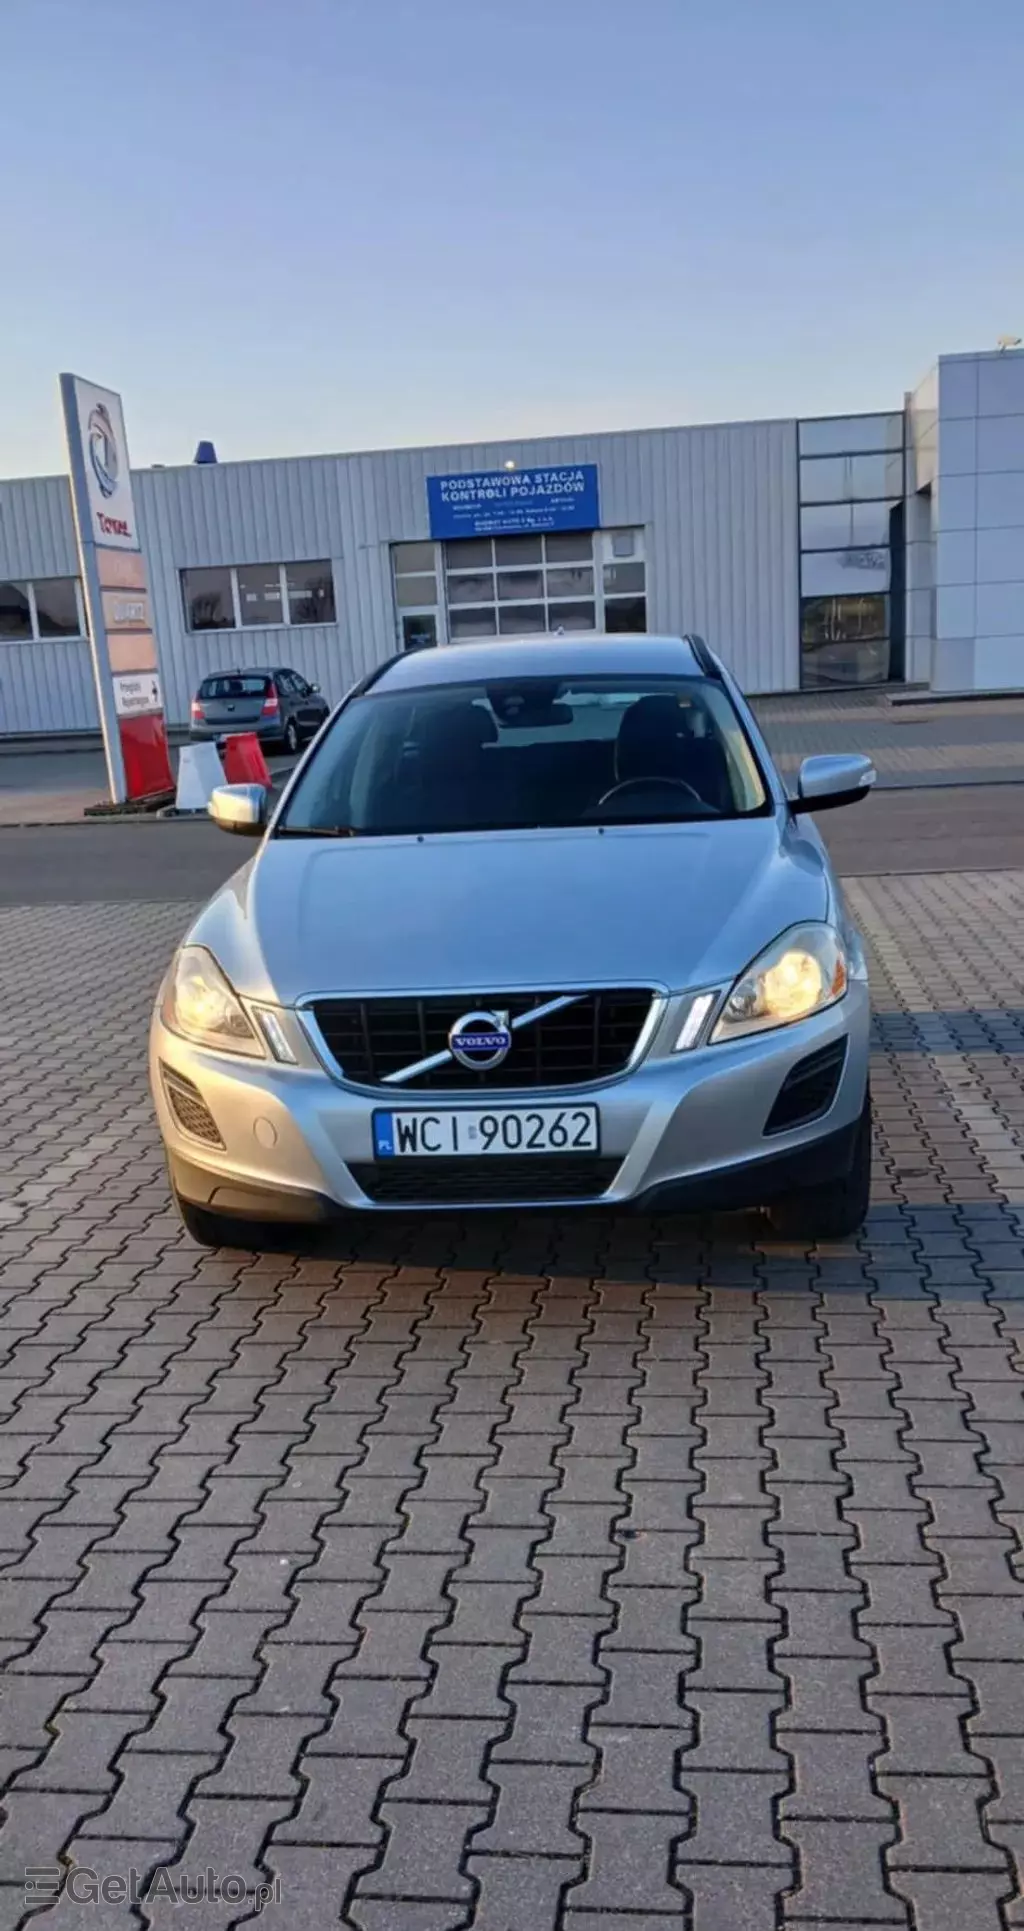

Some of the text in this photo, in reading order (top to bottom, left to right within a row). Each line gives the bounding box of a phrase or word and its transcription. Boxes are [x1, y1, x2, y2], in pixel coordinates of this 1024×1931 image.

[440, 470, 584, 490] PODSTAWOWA STACJA
[441, 481, 585, 502] KONTROLI POJAZDÓW
[454, 1035, 506, 1047] VOLVO
[396, 1111, 592, 1153] WCI 90262
[379, 1140, 393, 1151] PL
